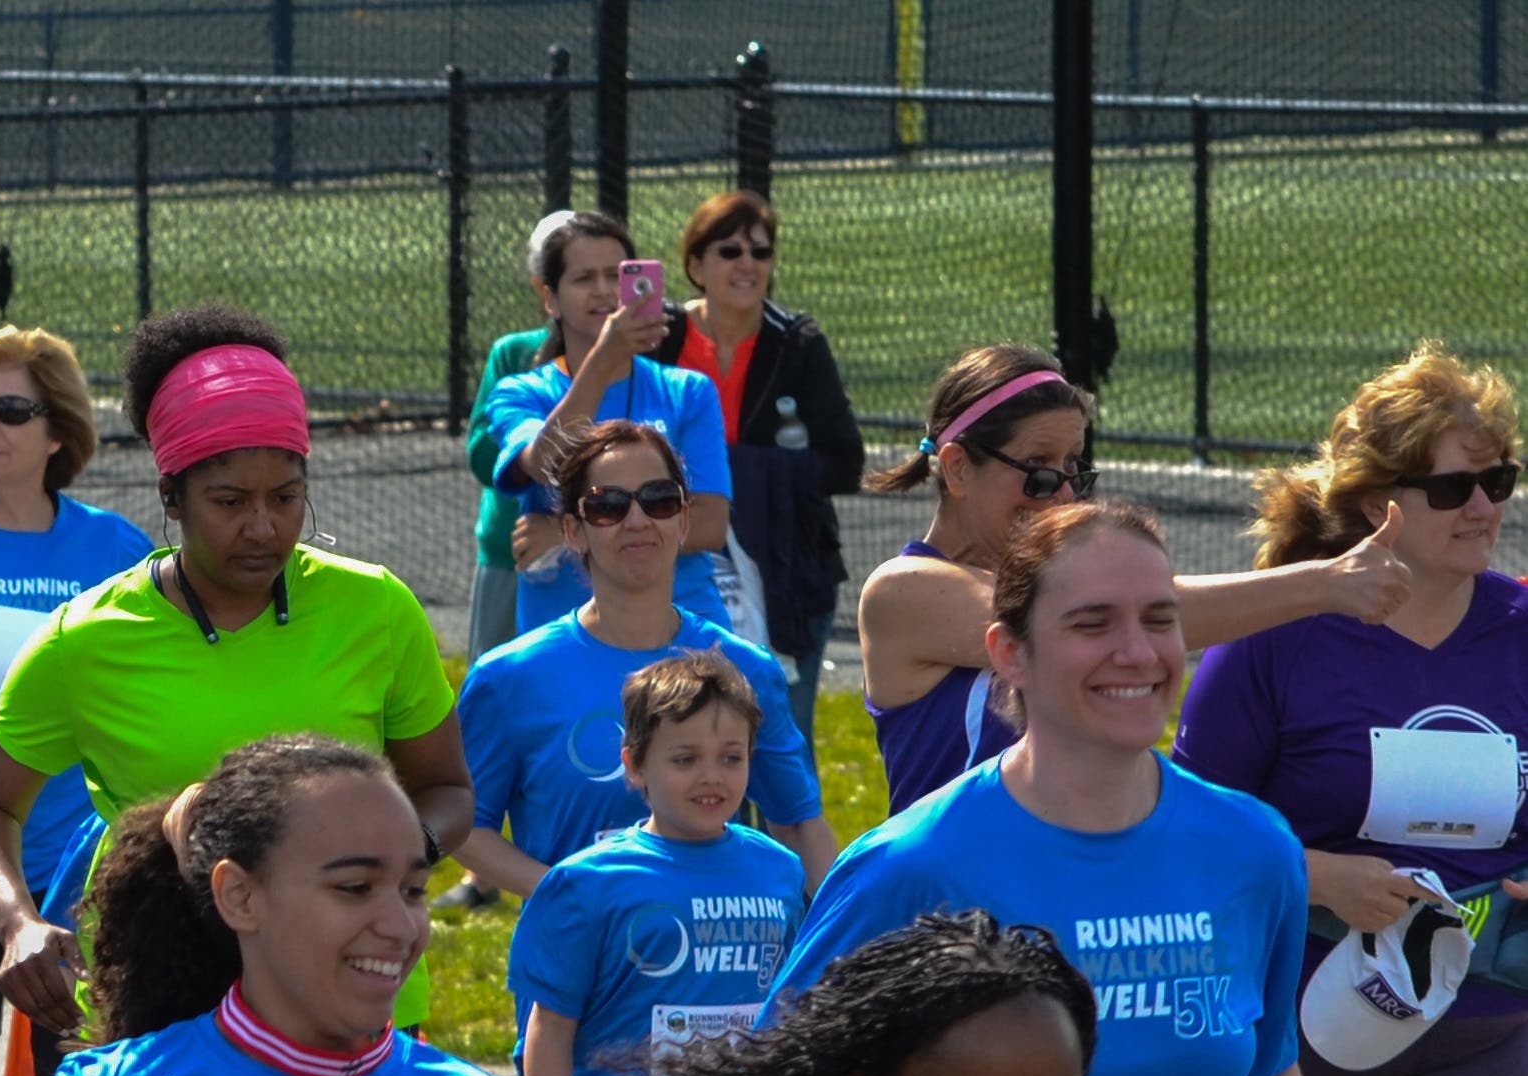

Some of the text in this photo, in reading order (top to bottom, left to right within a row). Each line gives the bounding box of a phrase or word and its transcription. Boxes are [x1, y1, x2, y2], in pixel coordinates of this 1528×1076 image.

[1075, 911, 1214, 950] RUNNING
[694, 945, 758, 973] WELL
[1078, 945, 1215, 981] WALKING
[1173, 975, 1244, 1039] 5K
[1364, 982, 1413, 1018] MRC
